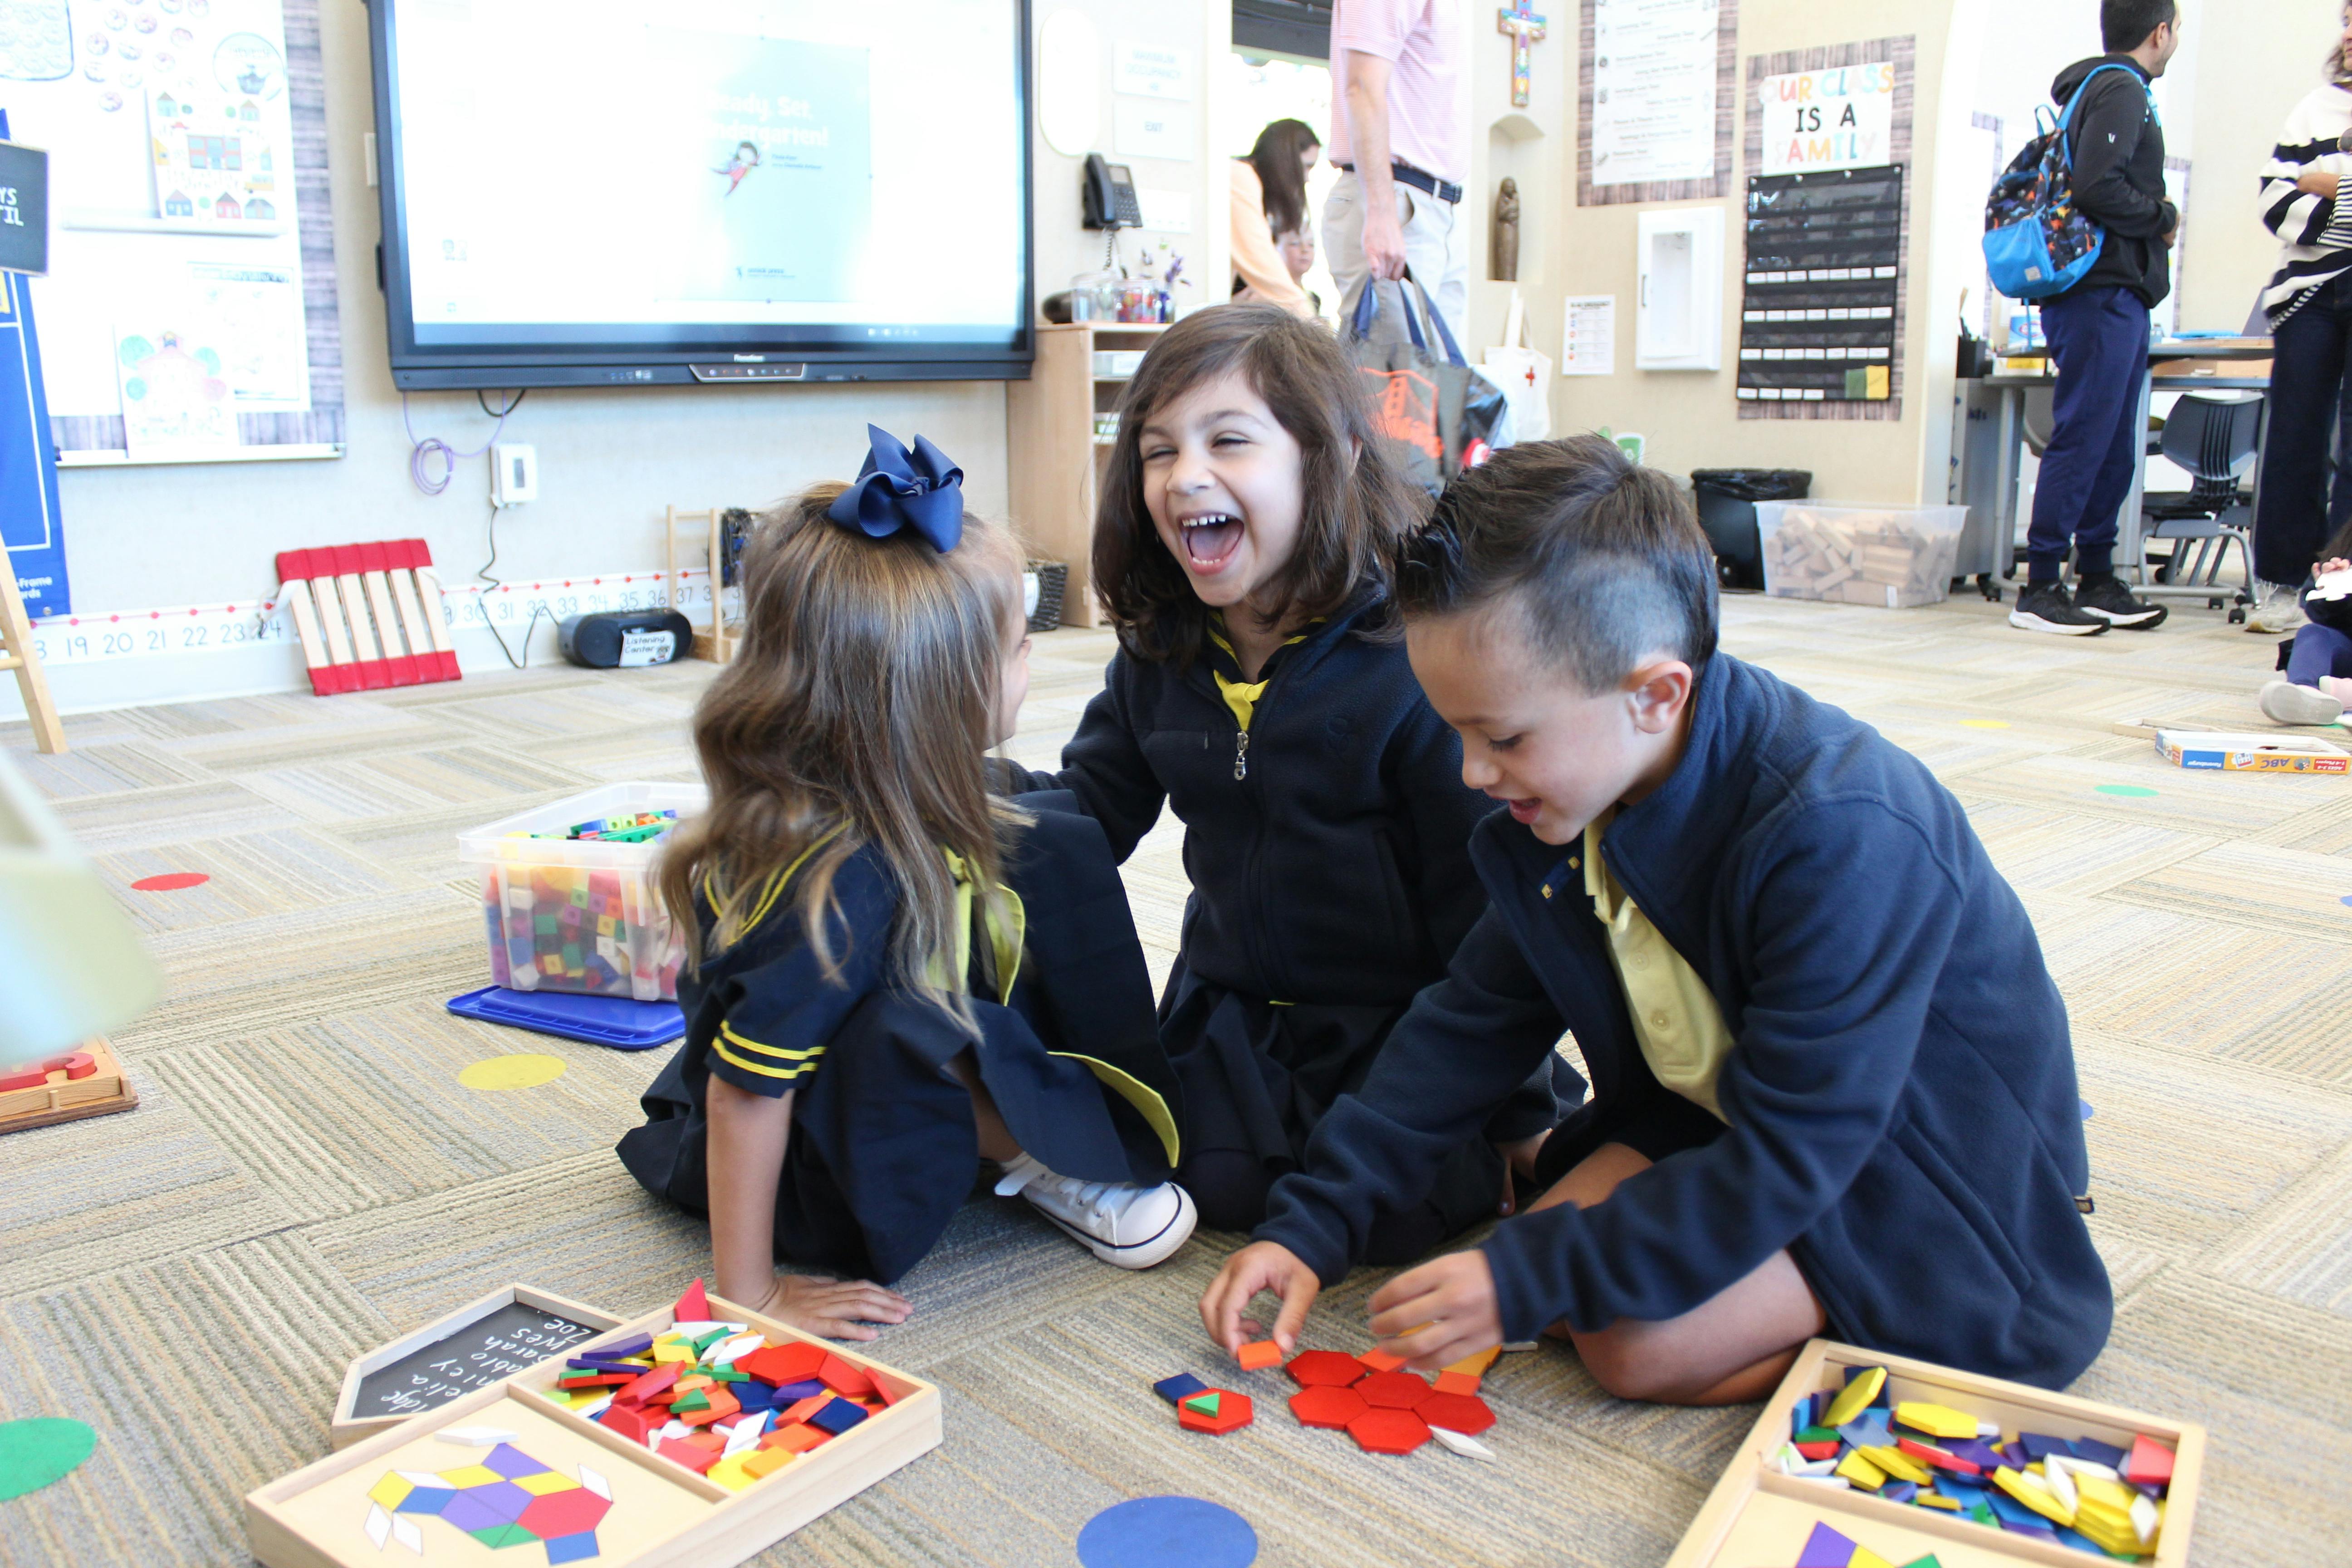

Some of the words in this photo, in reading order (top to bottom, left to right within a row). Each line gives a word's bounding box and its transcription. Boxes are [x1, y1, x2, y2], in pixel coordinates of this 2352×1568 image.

[1758, 75, 1812, 104] OUR
[1820, 64, 1895, 97] CLASS
[776, 94, 813, 121] Set,
[1795, 106, 1821, 132] IS
[1840, 103, 1856, 127] A
[1774, 132, 1877, 167] FAMILY
[463, 603, 487, 622] 30
[498, 602, 514, 620] 31
[527, 599, 547, 617] 32
[558, 596, 578, 615] 33
[588, 594, 609, 612] 34
[619, 591, 639, 610] 35
[647, 589, 667, 607] 36
[676, 586, 693, 604] 37
[67, 635, 88, 657] 19
[103, 632, 134, 654] 20
[147, 629, 167, 650] 21
[182, 625, 208, 647] 22
[220, 623, 246, 643] 23
[626, 636, 666, 645] Listening
[2186, 759, 2222, 768] Ravensburger
[2259, 757, 2291, 769] ABC
[544, 1318, 591, 1343] Zoe
